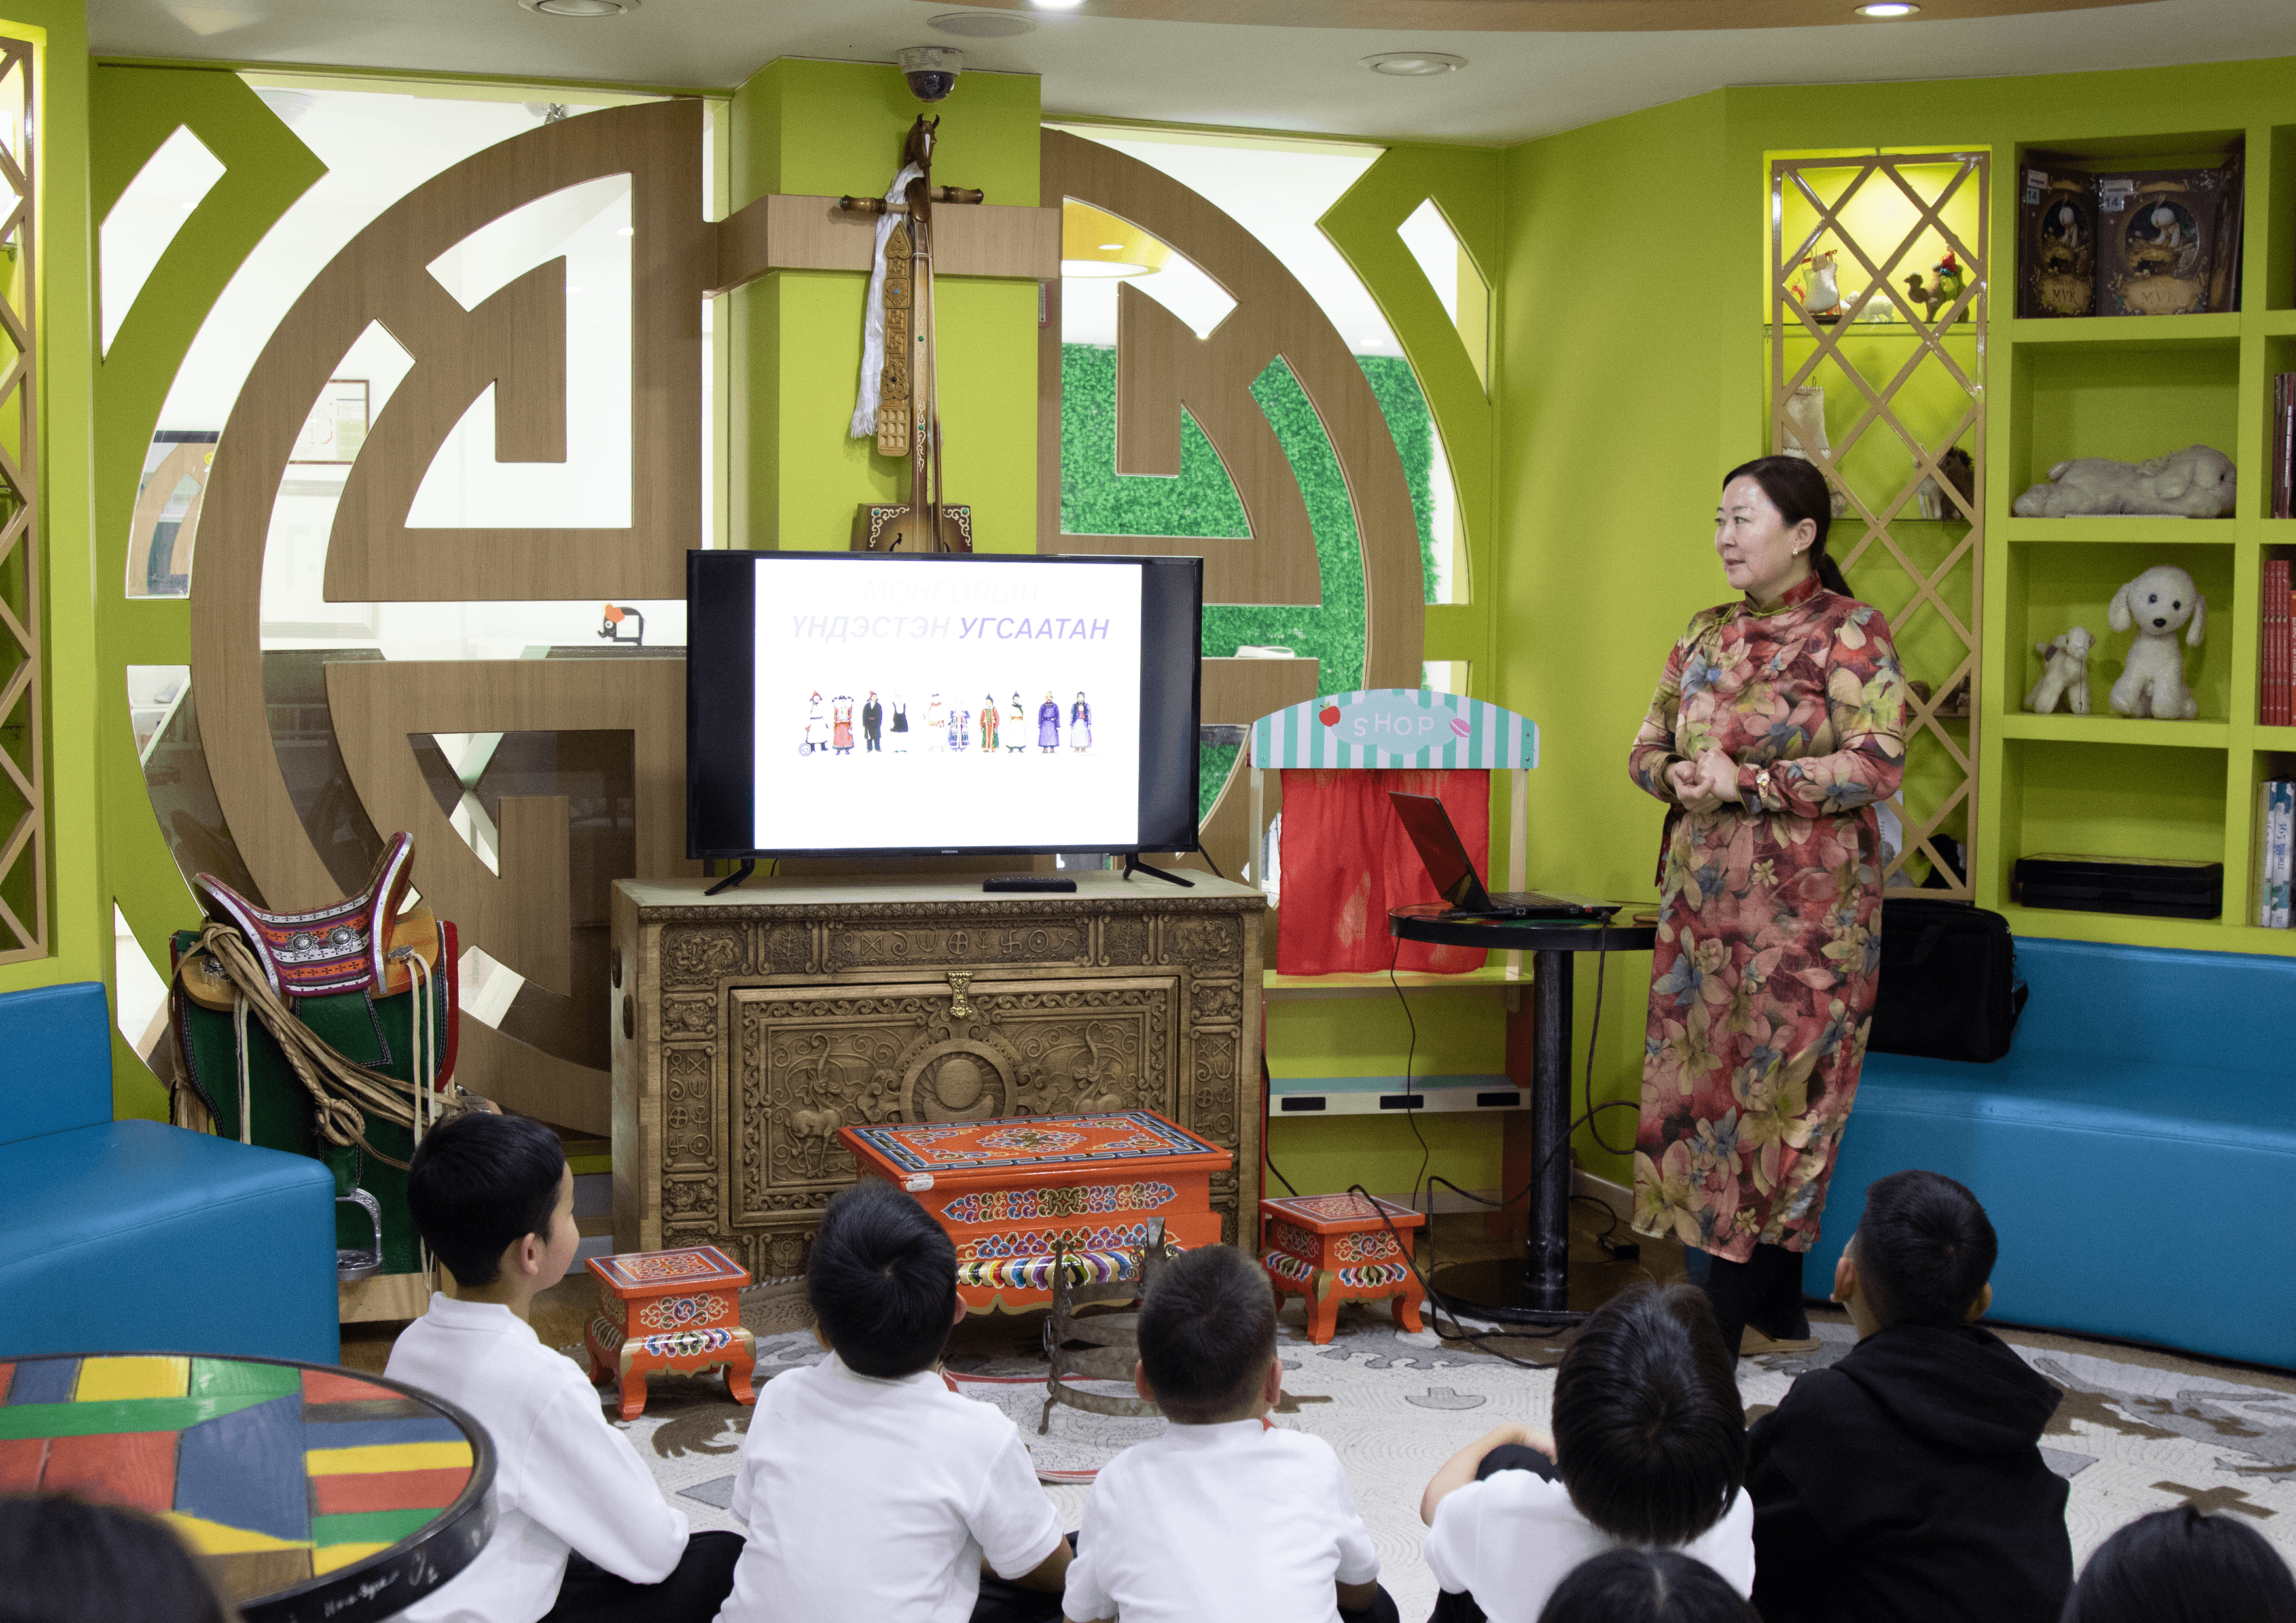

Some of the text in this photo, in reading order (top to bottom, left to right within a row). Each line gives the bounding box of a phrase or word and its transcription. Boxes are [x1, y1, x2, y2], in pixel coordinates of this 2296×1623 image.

[864, 580, 1040, 603] МОНГОЛЫН
[793, 616, 1110, 643] ҮНДЭСТЭН УГСААТАН
[1354, 713, 1435, 738] SHOP
